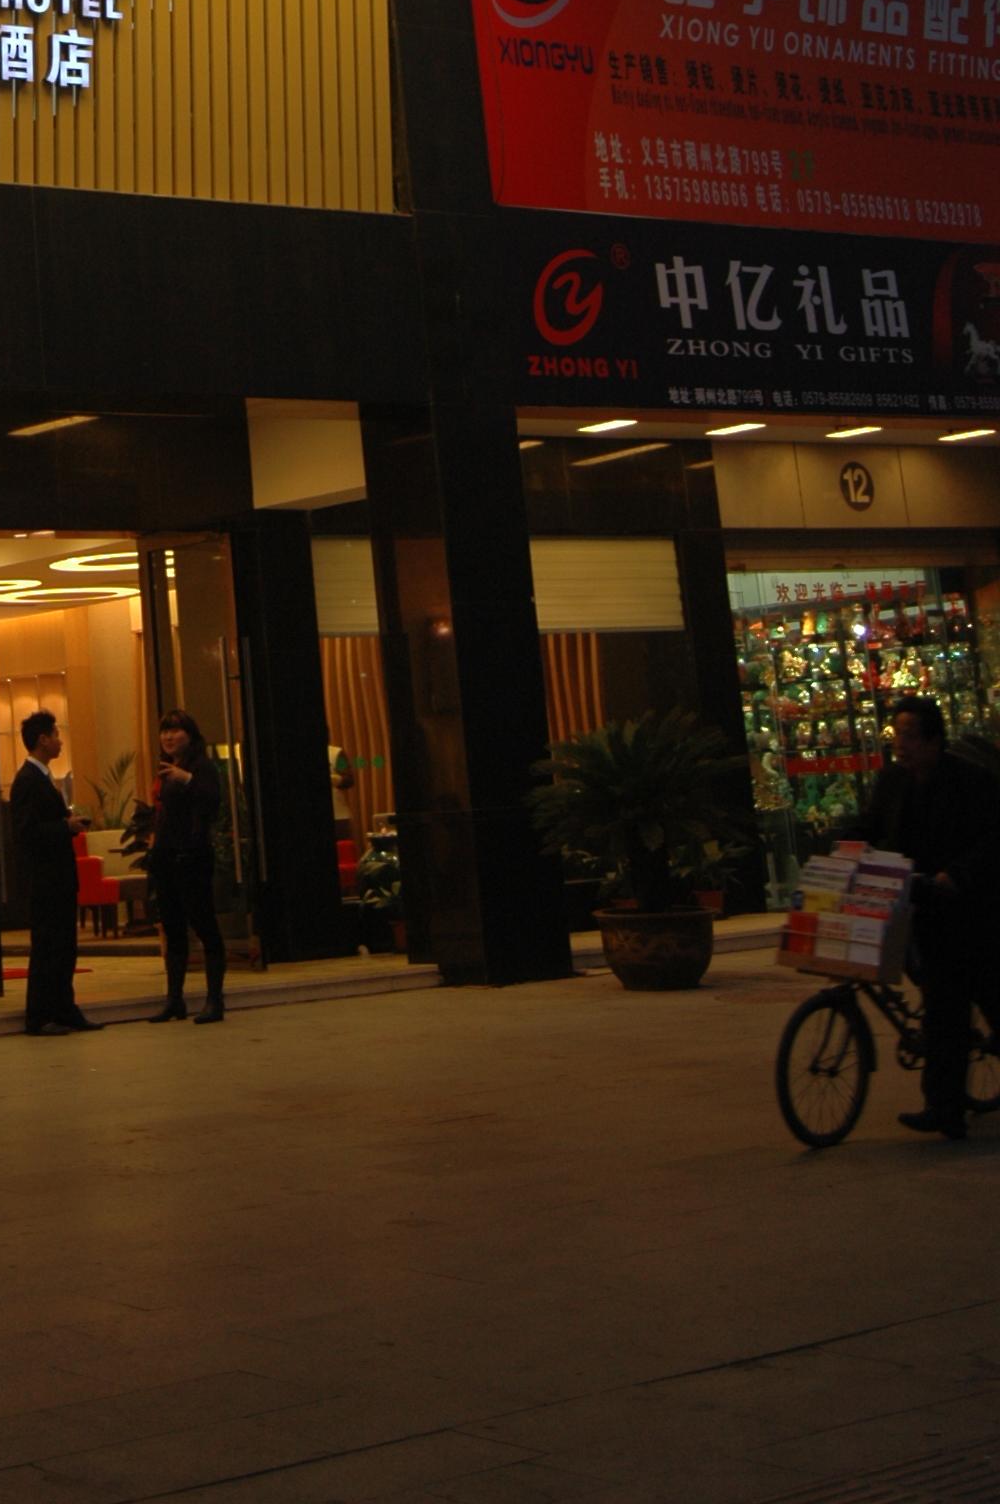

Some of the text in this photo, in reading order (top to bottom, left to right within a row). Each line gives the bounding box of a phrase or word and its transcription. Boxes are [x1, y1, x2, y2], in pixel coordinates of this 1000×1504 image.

[659, 13, 741, 47] XIONG
[750, 25, 776, 53] YU
[783, 30, 917, 72] ORNAMENTS
[654, 255, 912, 339] 中亿礼品
[527, 354, 640, 381] ZHONG YI
[666, 338, 915, 365] ZHONG YI GIFTS
[842, 466, 871, 504] 12
